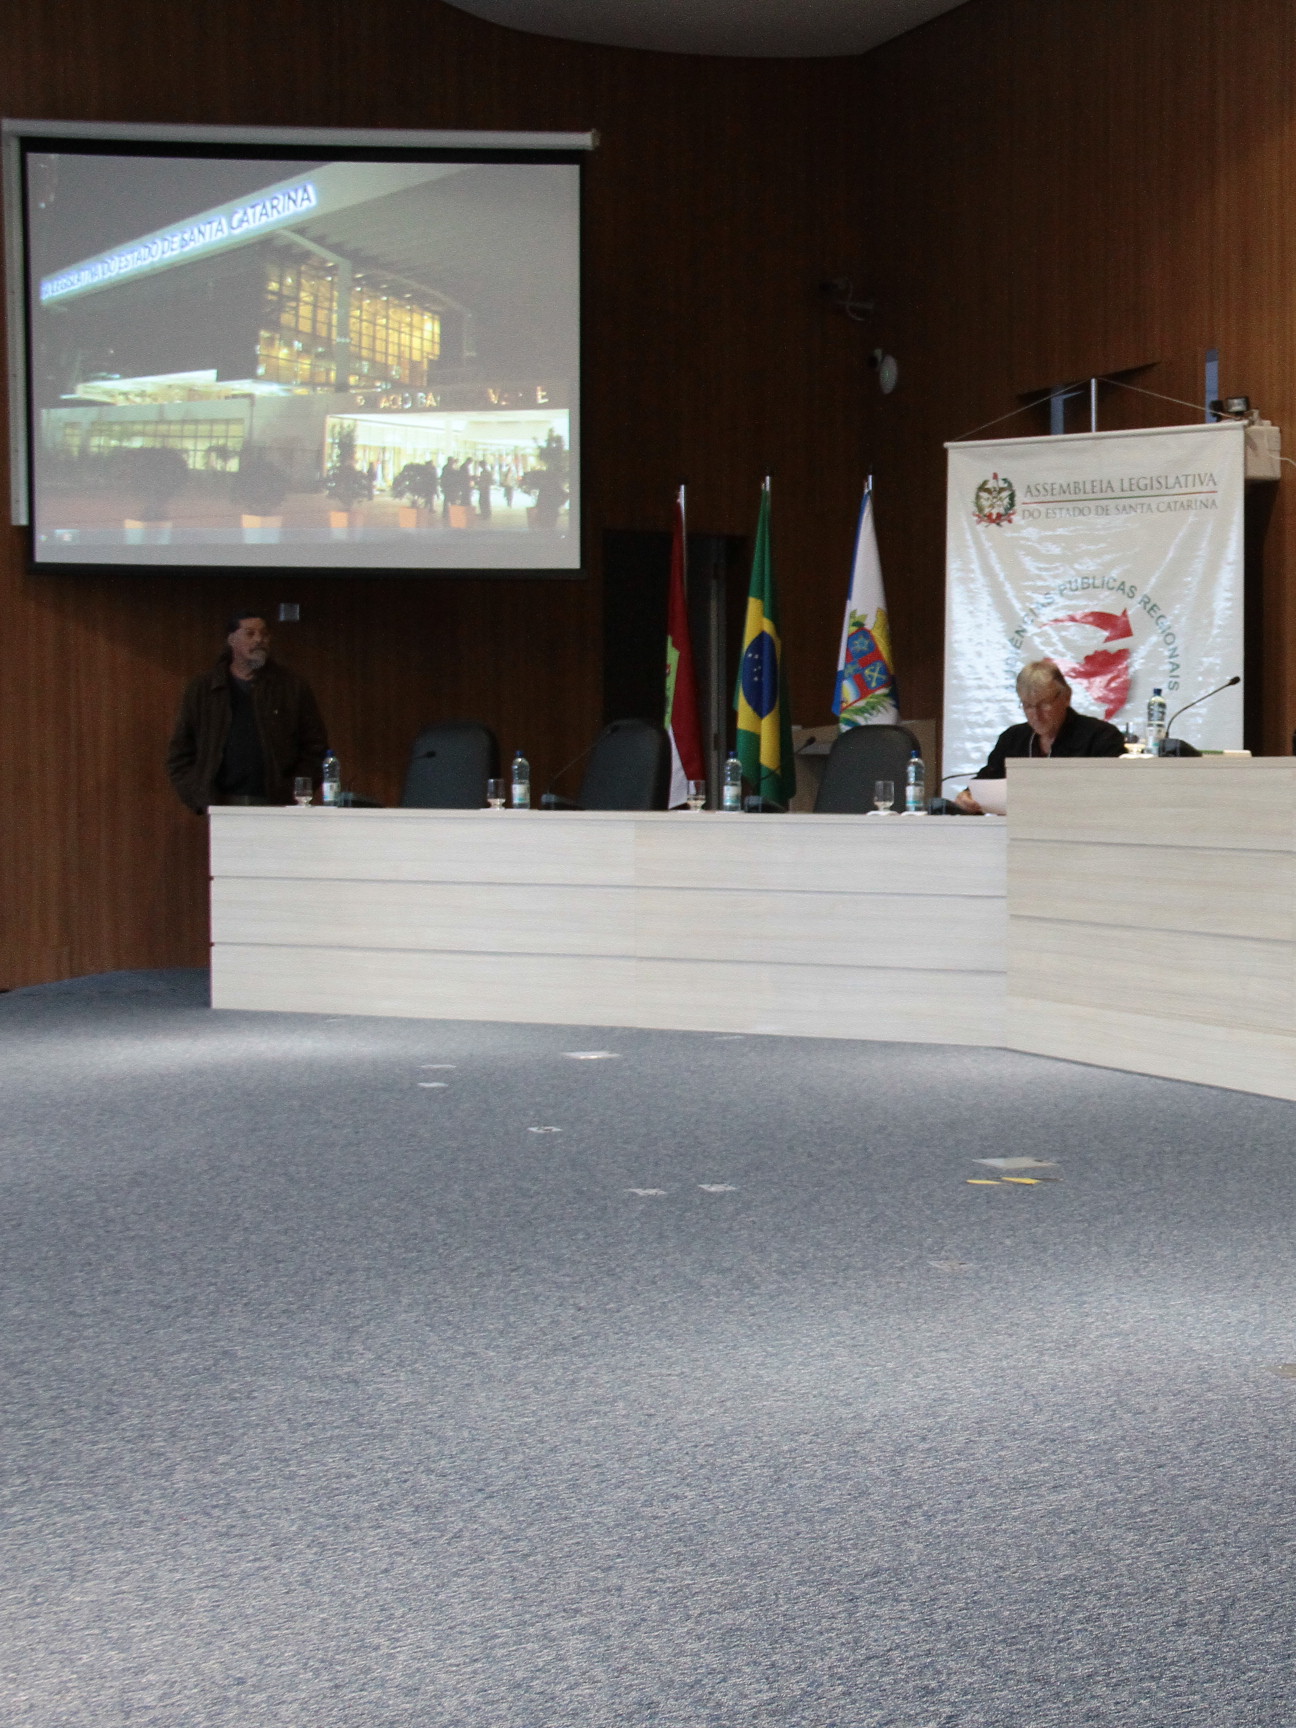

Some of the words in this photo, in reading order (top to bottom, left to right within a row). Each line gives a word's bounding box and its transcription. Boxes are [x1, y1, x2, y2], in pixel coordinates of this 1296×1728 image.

[180, 217, 228, 248] SANTA
[230, 184, 314, 231] CATARINA
[1024, 478, 1115, 498] ASSEMBLEIA
[1120, 472, 1218, 493] LEGISLATIVA
[1021, 508, 1042, 520] DO
[1045, 506, 1092, 520] ESTADO
[1095, 504, 1110, 516] DE
[1115, 502, 1154, 514] SANTA
[1156, 498, 1218, 514] CATARINA
[1138, 593, 1181, 692] REGIONAIS
